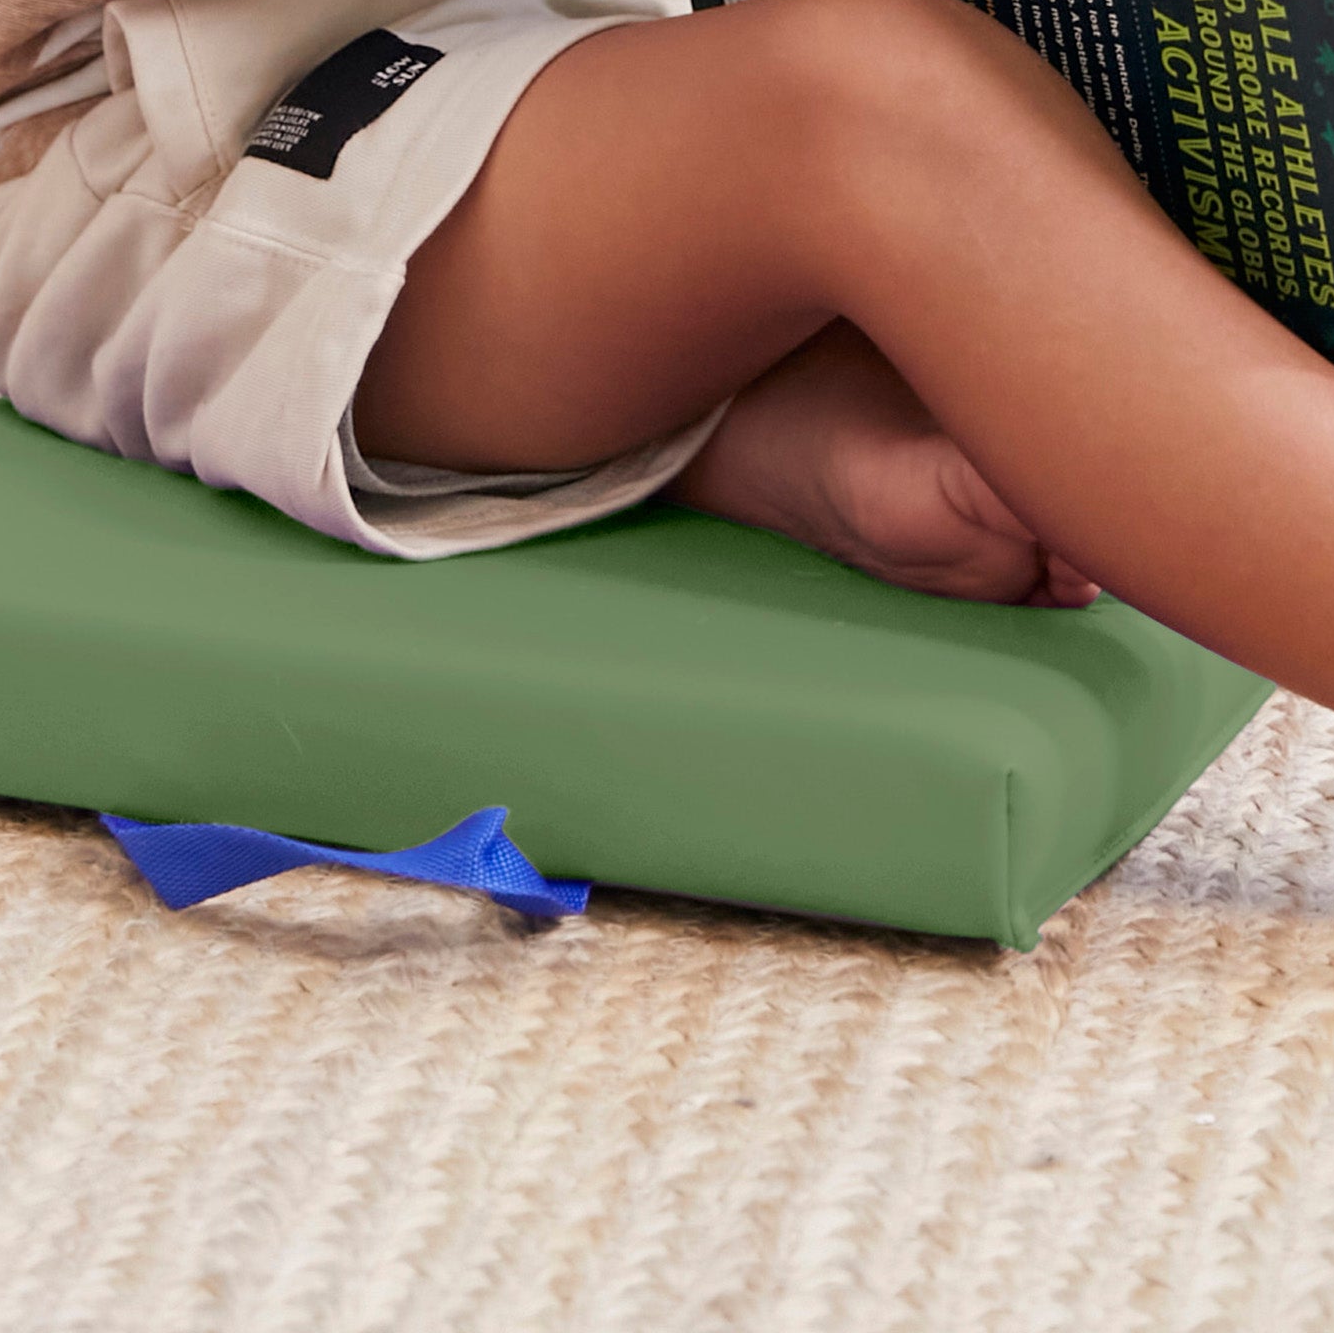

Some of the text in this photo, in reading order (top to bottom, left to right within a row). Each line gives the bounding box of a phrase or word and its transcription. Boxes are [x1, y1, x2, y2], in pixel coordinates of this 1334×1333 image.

[1029, 3, 1044, 29] the
[1068, 9, 1080, 24] A
[1086, 8, 1102, 38] lost
[1105, 12, 1122, 39] the
[1045, 5, 1064, 48] many
[1055, 50, 1071, 84] mor
[1070, 25, 1092, 84] football
[1092, 41, 1108, 70] her
[1098, 71, 1112, 102] arm
[1109, 41, 1136, 113] Kentucky
[1227, 28, 1271, 140] BROKE
[1104, 105, 1118, 122] in
[1215, 118, 1248, 184] THE
[1227, 186, 1268, 290] GLOBE
